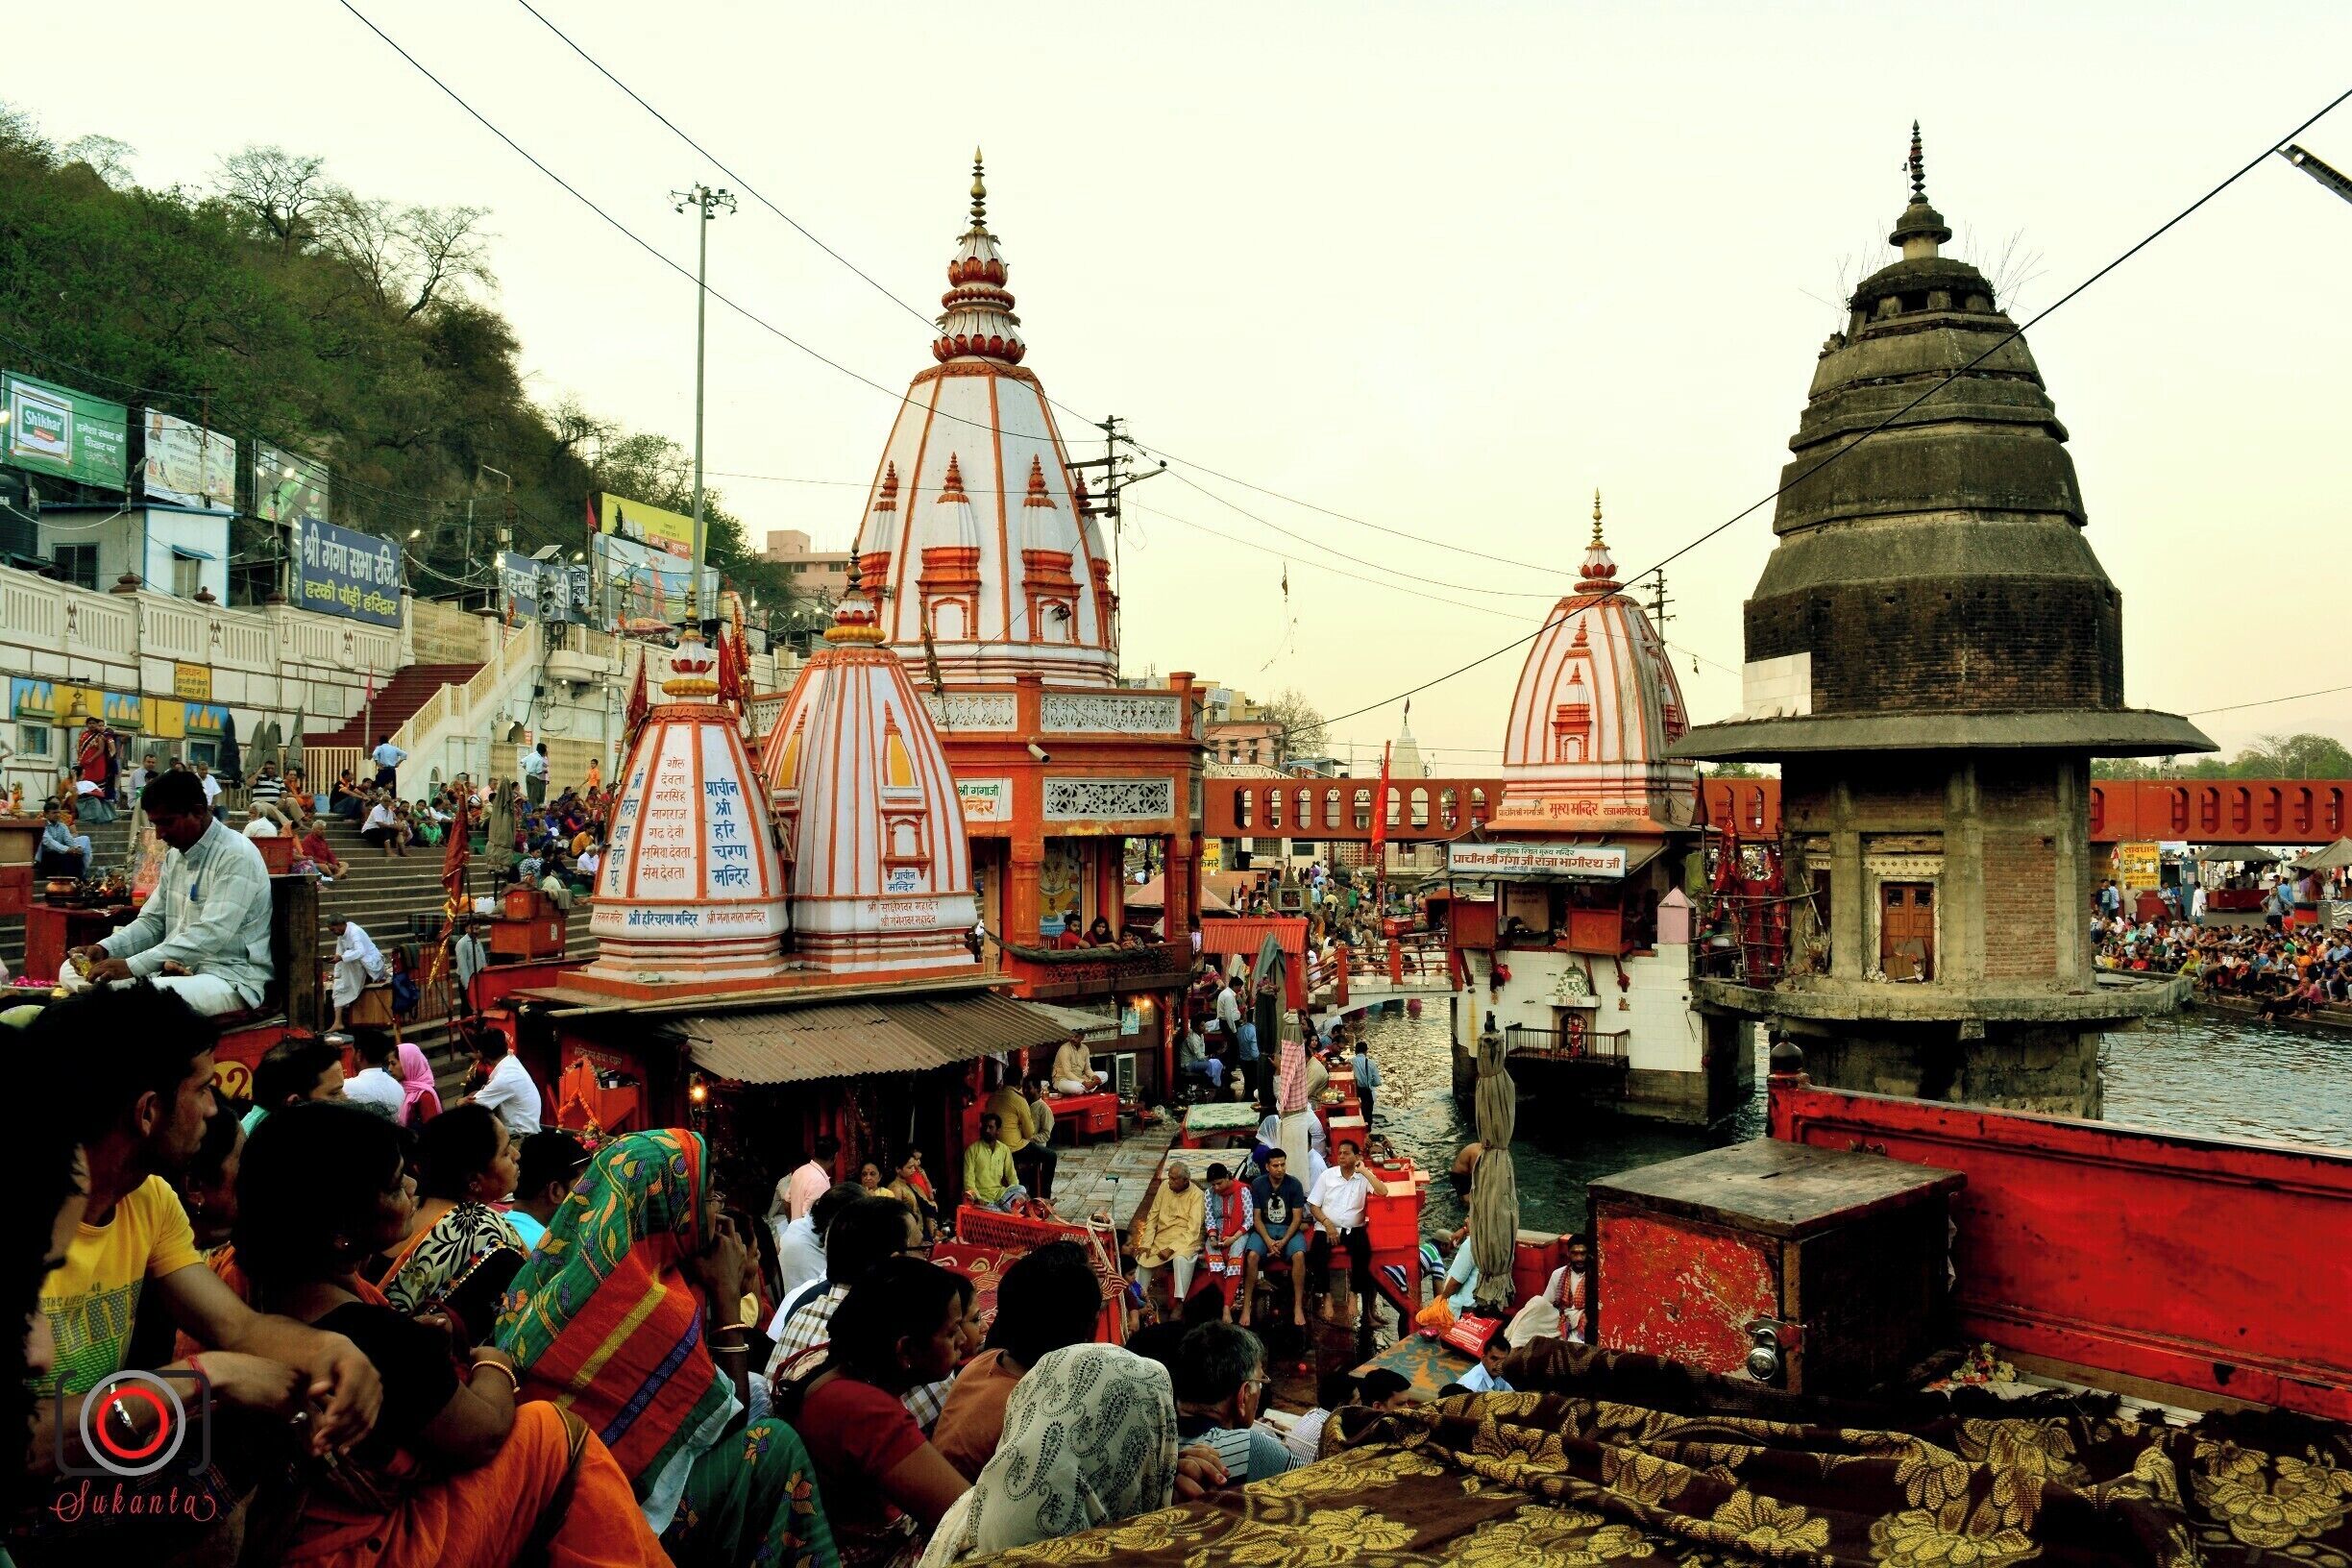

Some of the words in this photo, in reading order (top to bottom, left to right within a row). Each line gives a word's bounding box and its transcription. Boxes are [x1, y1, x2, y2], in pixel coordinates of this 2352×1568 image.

[25, 410, 62, 431] Shikhar
[85, 435, 106, 451] शिखर
[304, 523, 320, 568] श्री
[322, 530, 348, 576] गंगा
[350, 547, 373, 582] सभा
[375, 544, 399, 587] रजि.
[306, 578, 336, 601] हरकी
[363, 591, 398, 616] हरिद्वार
[661, 772, 685, 787] देवता
[705, 777, 739, 796] प्राचीन
[655, 788, 686, 803] नरसिंह
[958, 784, 968, 796] श्री
[716, 798, 732, 816] श्री
[962, 796, 994, 815] न्दिर
[1549, 802, 1570, 819] मुख्य
[1571, 799, 1599, 817] मन्दिर
[1641, 806, 1650, 817] जी
[651, 809, 688, 820] नागराज
[667, 824, 685, 841] देवी
[713, 820, 738, 842] हरि
[669, 845, 691, 861] देवता
[712, 845, 748, 861] चरण
[1556, 847, 1575, 856] मन्दिर
[1453, 852, 1485, 865] प्राचीन
[1486, 852, 1498, 865] श्री
[1500, 854, 1520, 865] गंगा
[1521, 854, 1533, 866] जी
[1535, 857, 1558, 867] राजा
[1559, 856, 1605, 869] भागीरथ
[1605, 856, 1621, 870] जी
[660, 864, 685, 881] देवता
[712, 865, 750, 889] मन्दिर
[894, 870, 916, 880] प्राचीन
[887, 881, 916, 893] मन्दिर
[628, 909, 641, 925] श्री
[674, 910, 699, 928] मन्दिर
[706, 910, 716, 924] श्री
[745, 909, 767, 925] मन्दिर
